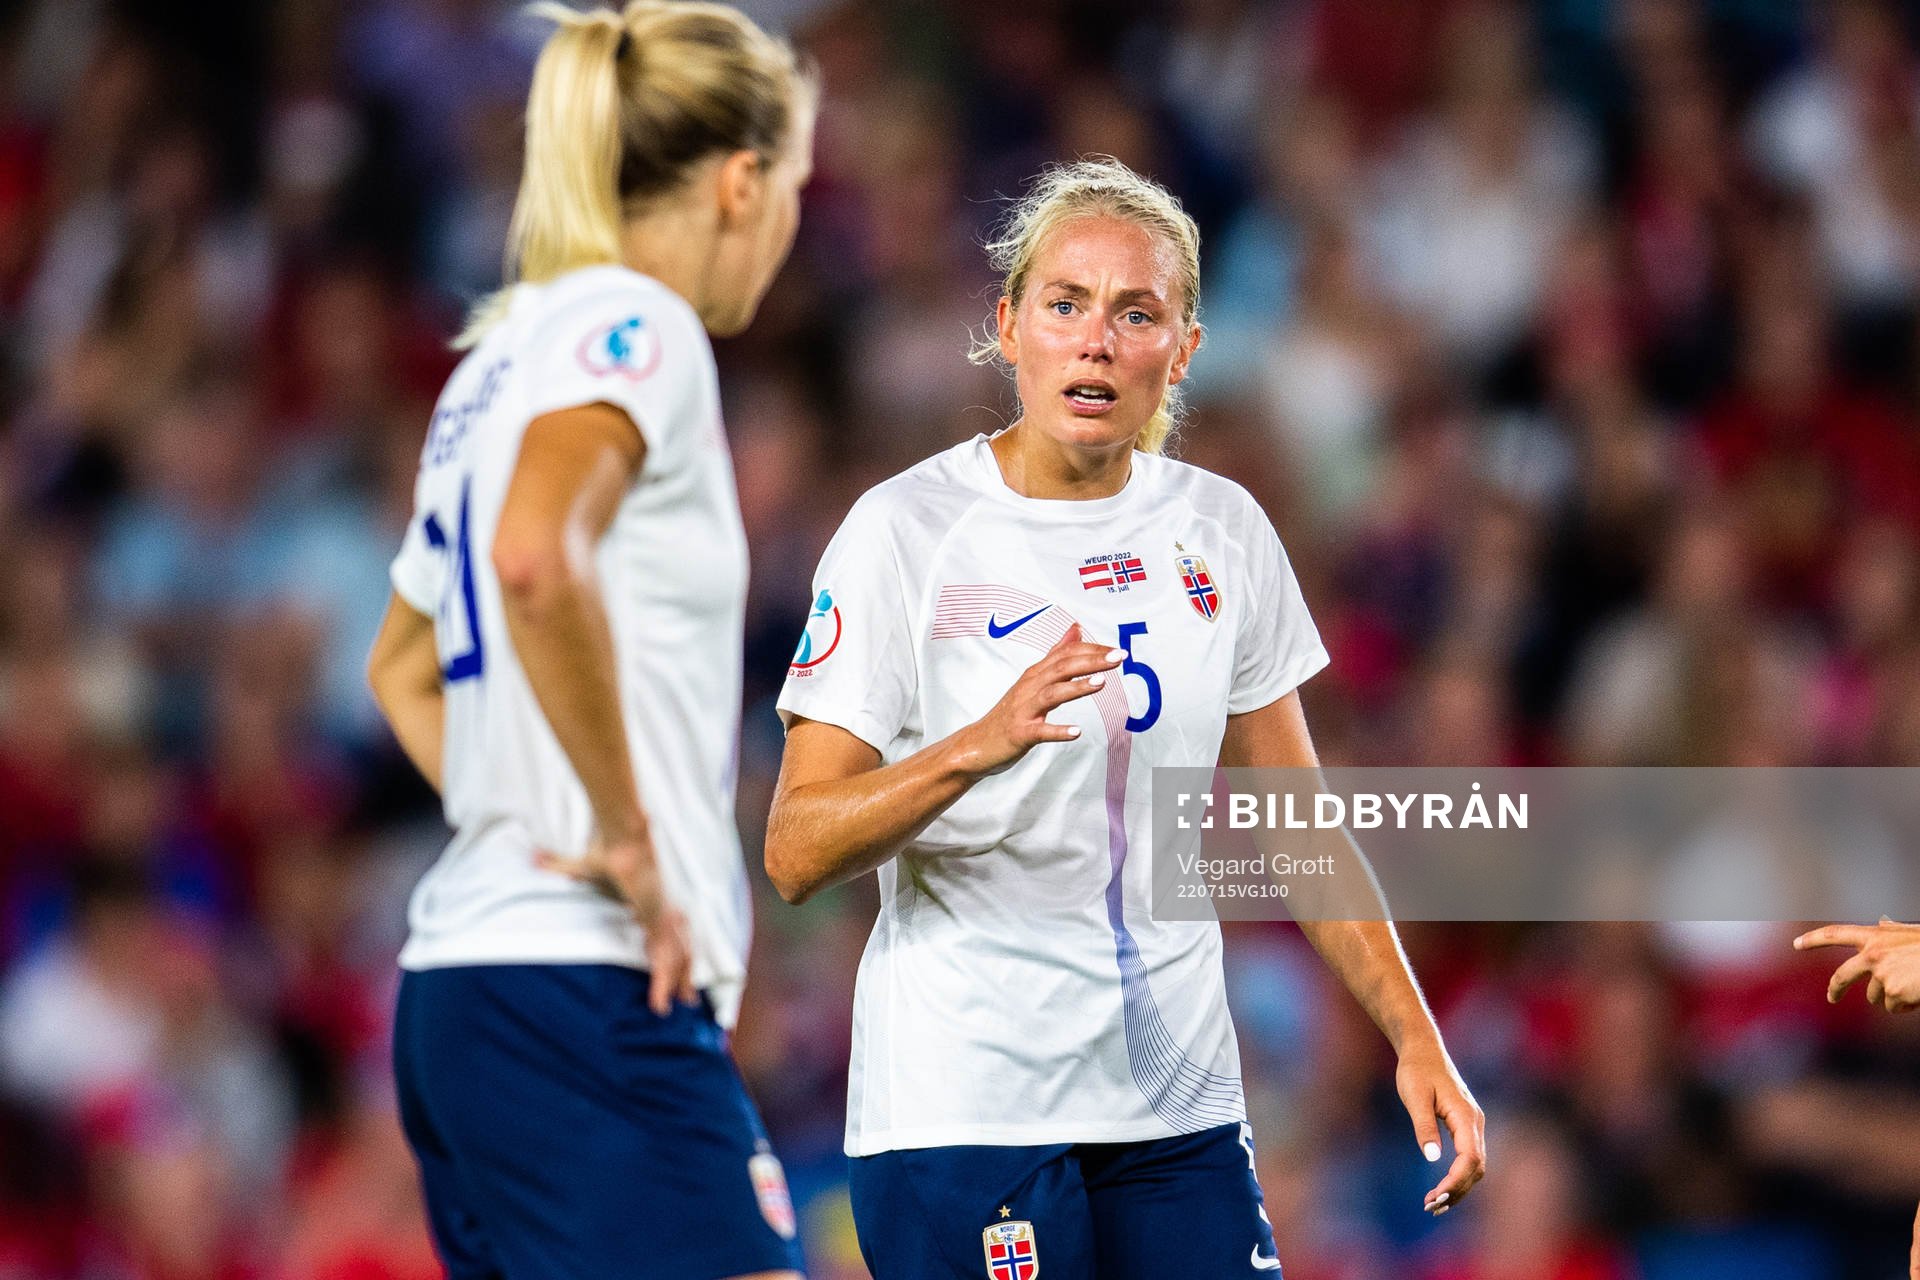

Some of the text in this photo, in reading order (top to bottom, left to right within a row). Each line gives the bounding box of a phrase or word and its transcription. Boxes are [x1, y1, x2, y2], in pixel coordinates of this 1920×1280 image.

[1084, 551, 1131, 565] WEURO 2022
[797, 669, 813, 677] 2022
[1118, 621, 1162, 733] 5
